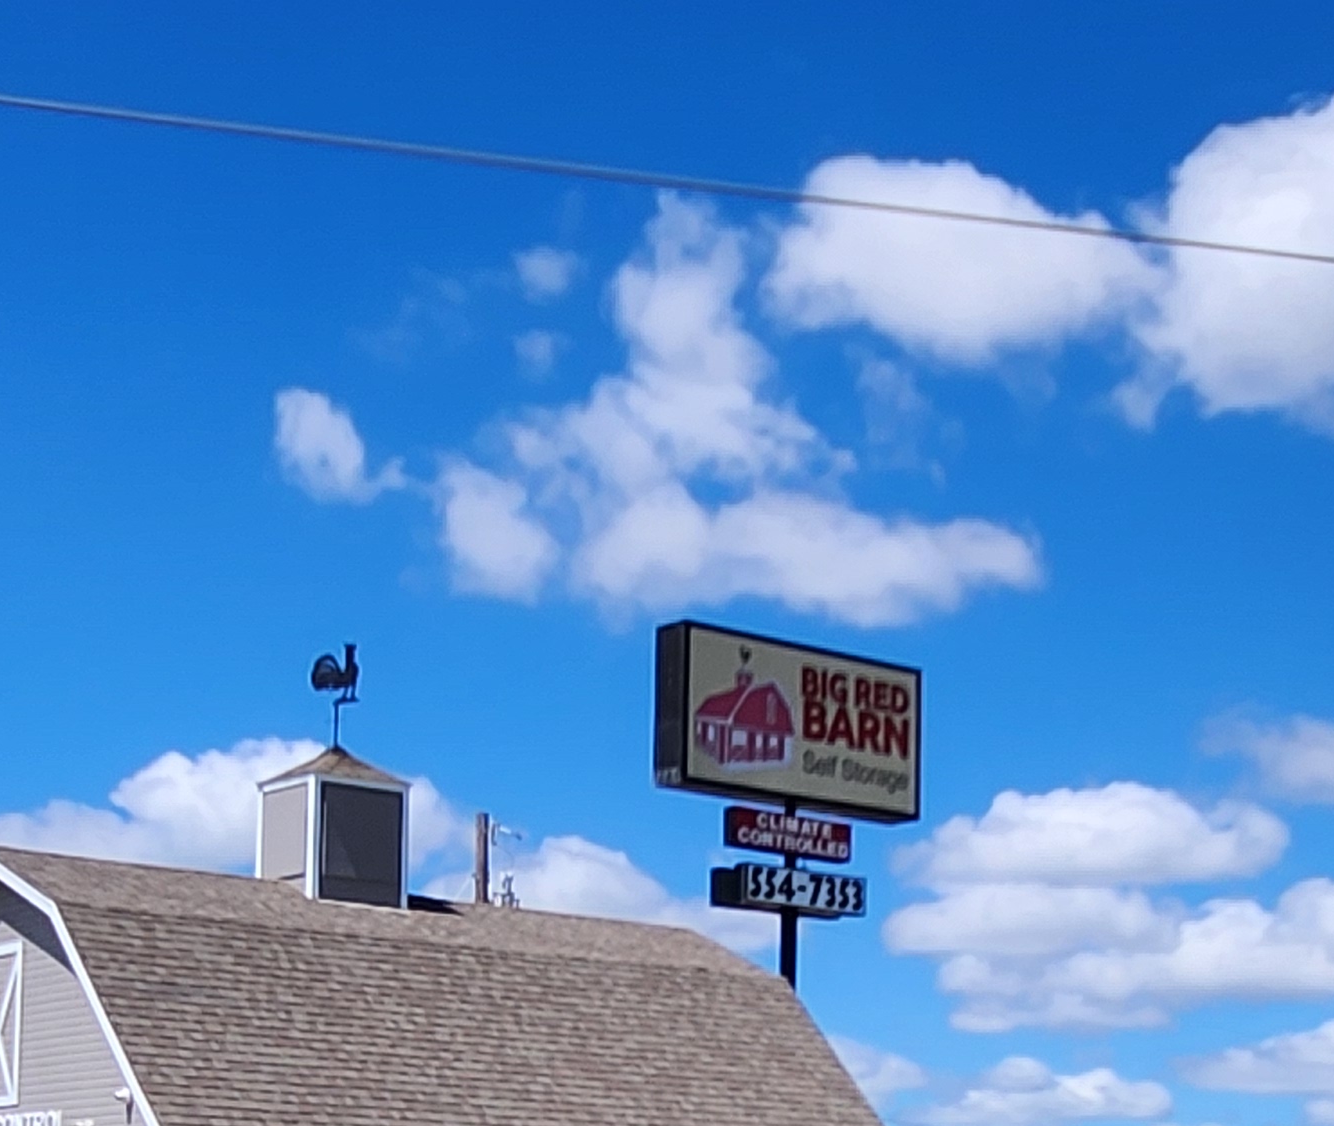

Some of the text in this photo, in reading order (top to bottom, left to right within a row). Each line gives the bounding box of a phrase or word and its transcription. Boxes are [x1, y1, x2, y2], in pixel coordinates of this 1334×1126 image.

[801, 666, 910, 714] BIG RED
[802, 701, 910, 759] BARN
[803, 750, 909, 795] Self Storage
[737, 827, 848, 859] CONTROLLED
[756, 813, 832, 839] CLIMATE
[750, 866, 863, 911] 554-7353
